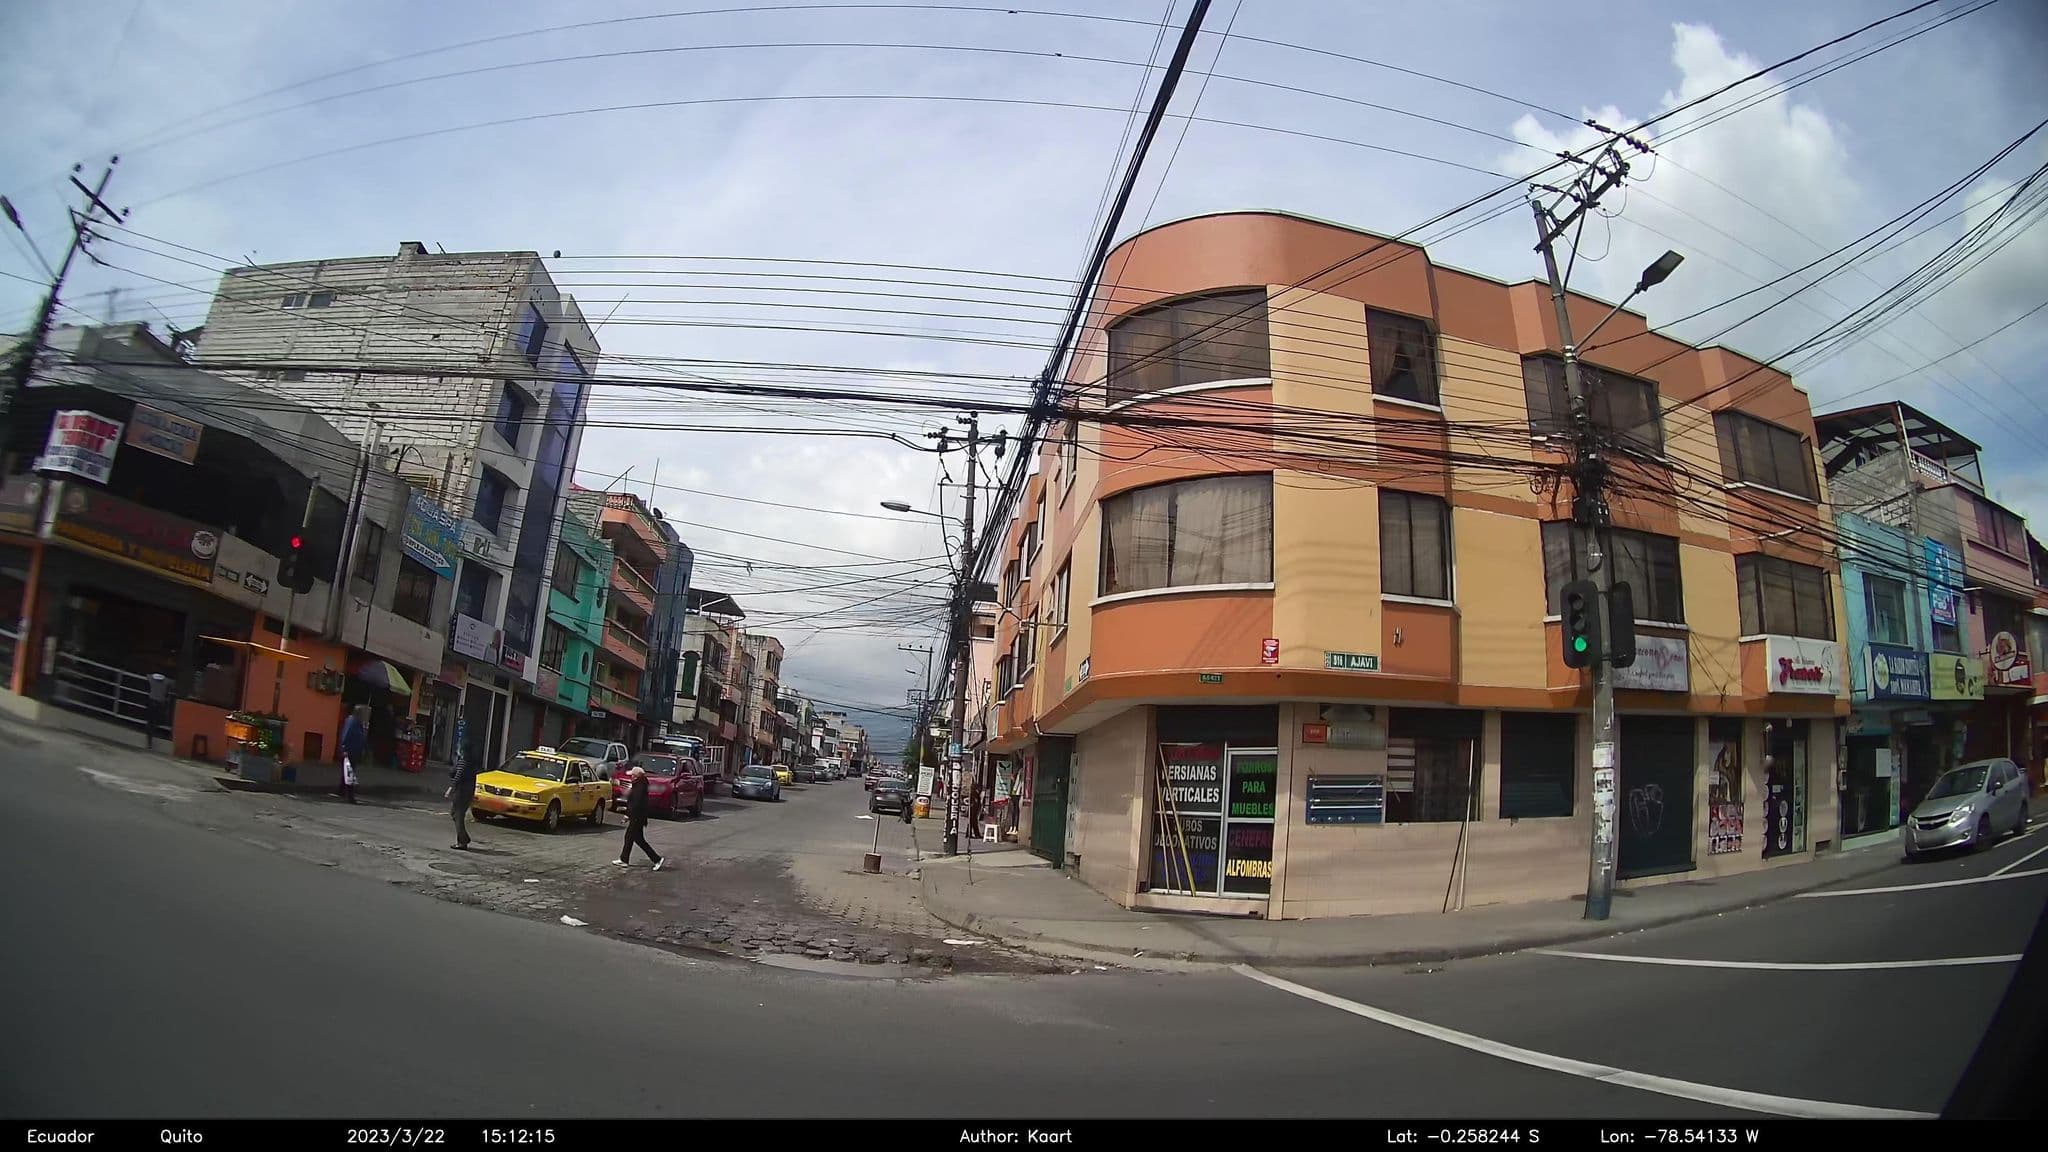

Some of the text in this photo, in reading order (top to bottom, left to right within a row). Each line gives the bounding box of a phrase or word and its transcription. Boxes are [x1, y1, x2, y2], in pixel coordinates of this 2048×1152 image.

[1350, 655, 1374, 669] AJAVI
[1242, 780, 1266, 793] PARA
[1160, 787, 1220, 803] VERTICALES
[1231, 802, 1274, 816] MUEBLES
[1154, 834, 1218, 850] DECOATIVOS
[1225, 859, 1273, 879] ALFOMBRAS
